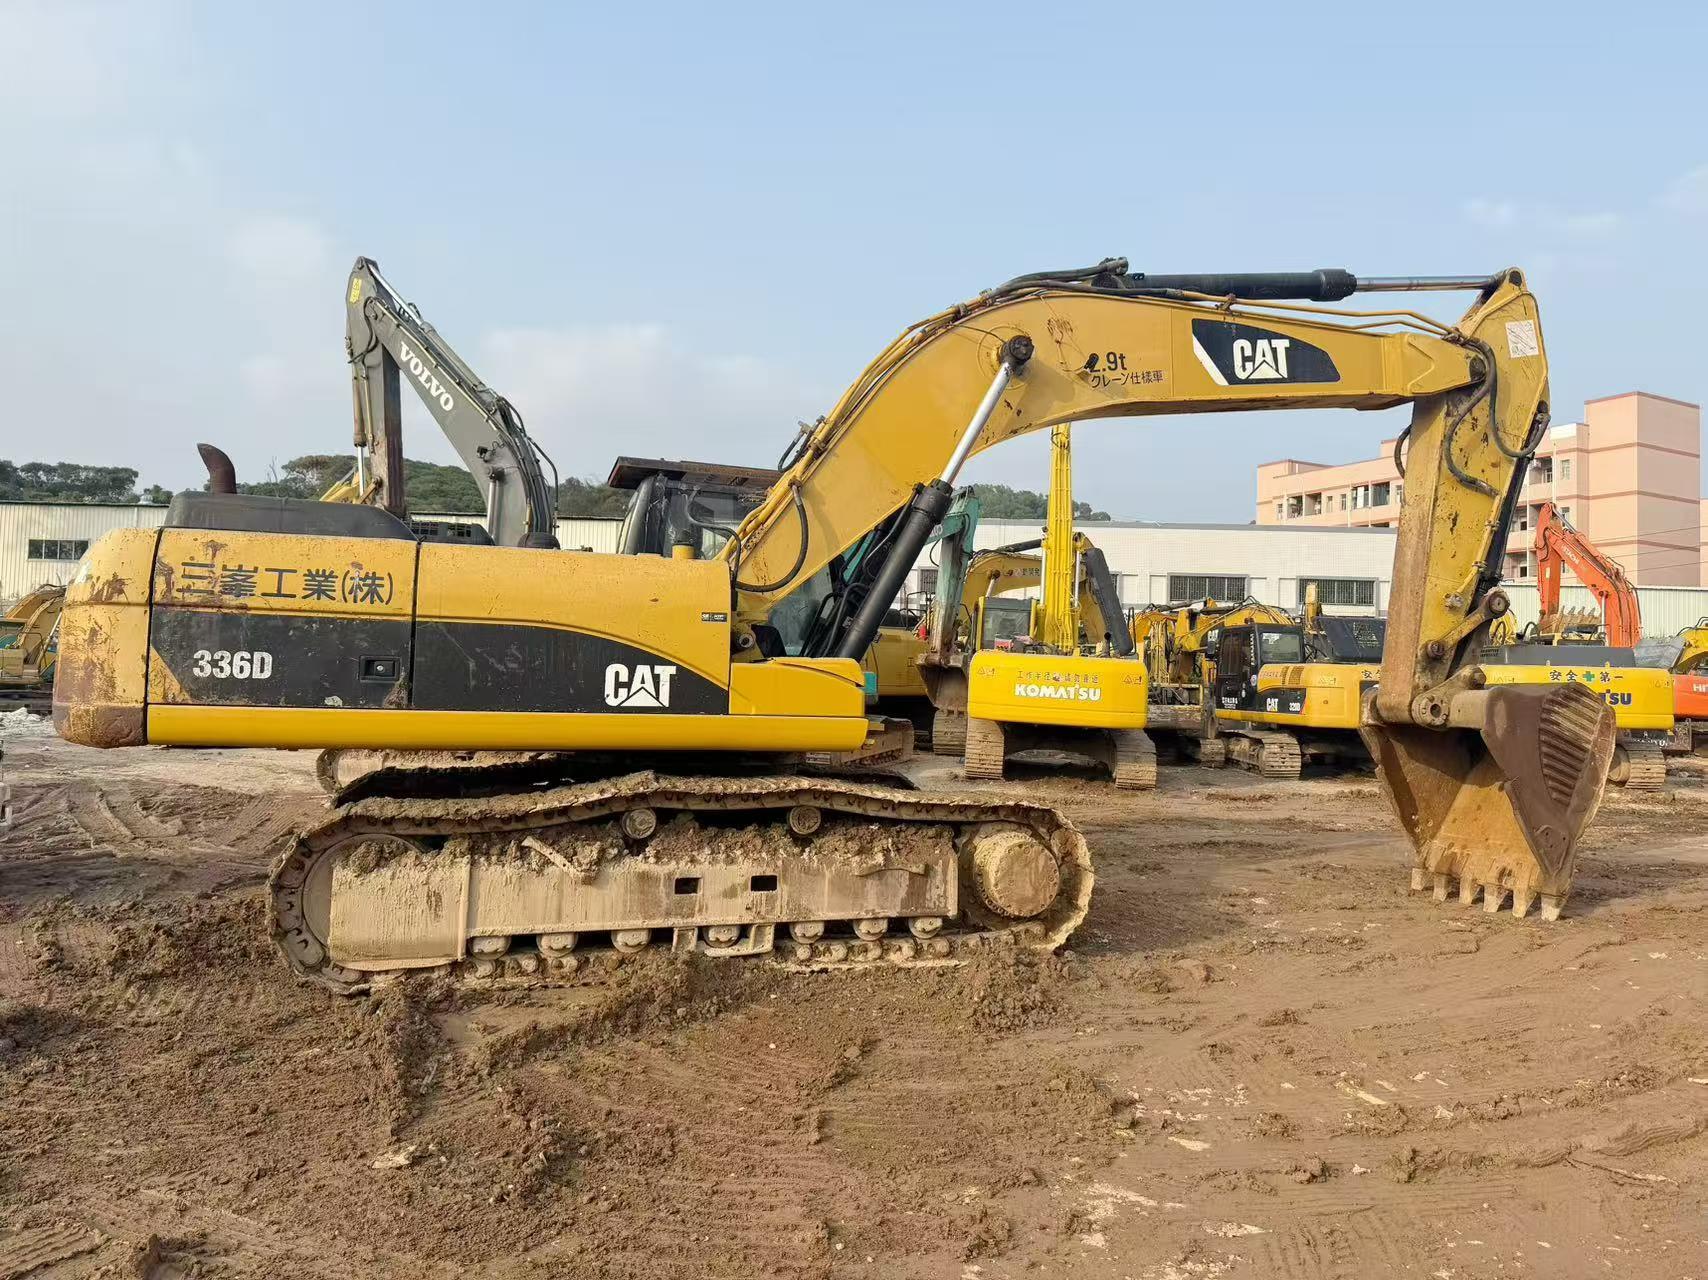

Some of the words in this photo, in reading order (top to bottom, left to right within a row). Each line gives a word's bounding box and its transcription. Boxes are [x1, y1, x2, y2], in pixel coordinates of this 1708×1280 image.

[399, 341, 455, 412] VOLVO
[1233, 339, 1290, 380] CAT
[192, 650, 273, 680] 336D
[1549, 669, 1578, 682] 安全
[604, 663, 677, 708] CAT
[1014, 683, 1101, 701] KOMATSU
